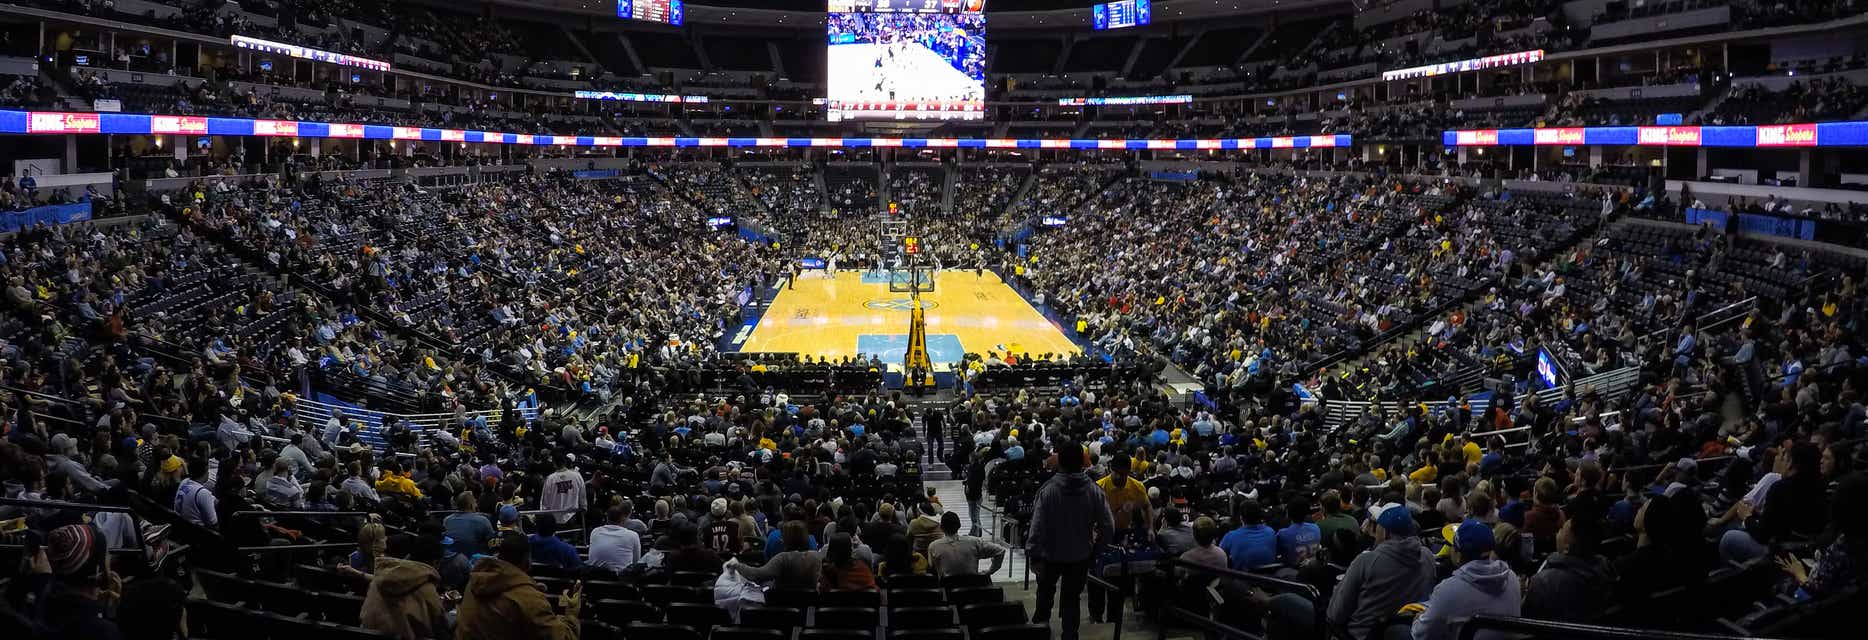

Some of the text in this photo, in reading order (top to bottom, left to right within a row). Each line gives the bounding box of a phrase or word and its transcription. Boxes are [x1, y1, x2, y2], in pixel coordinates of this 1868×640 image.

[1641, 128, 1698, 144] KING Soopers
[1759, 126, 1813, 144] KING Soopers
[712, 534, 731, 552] 42
